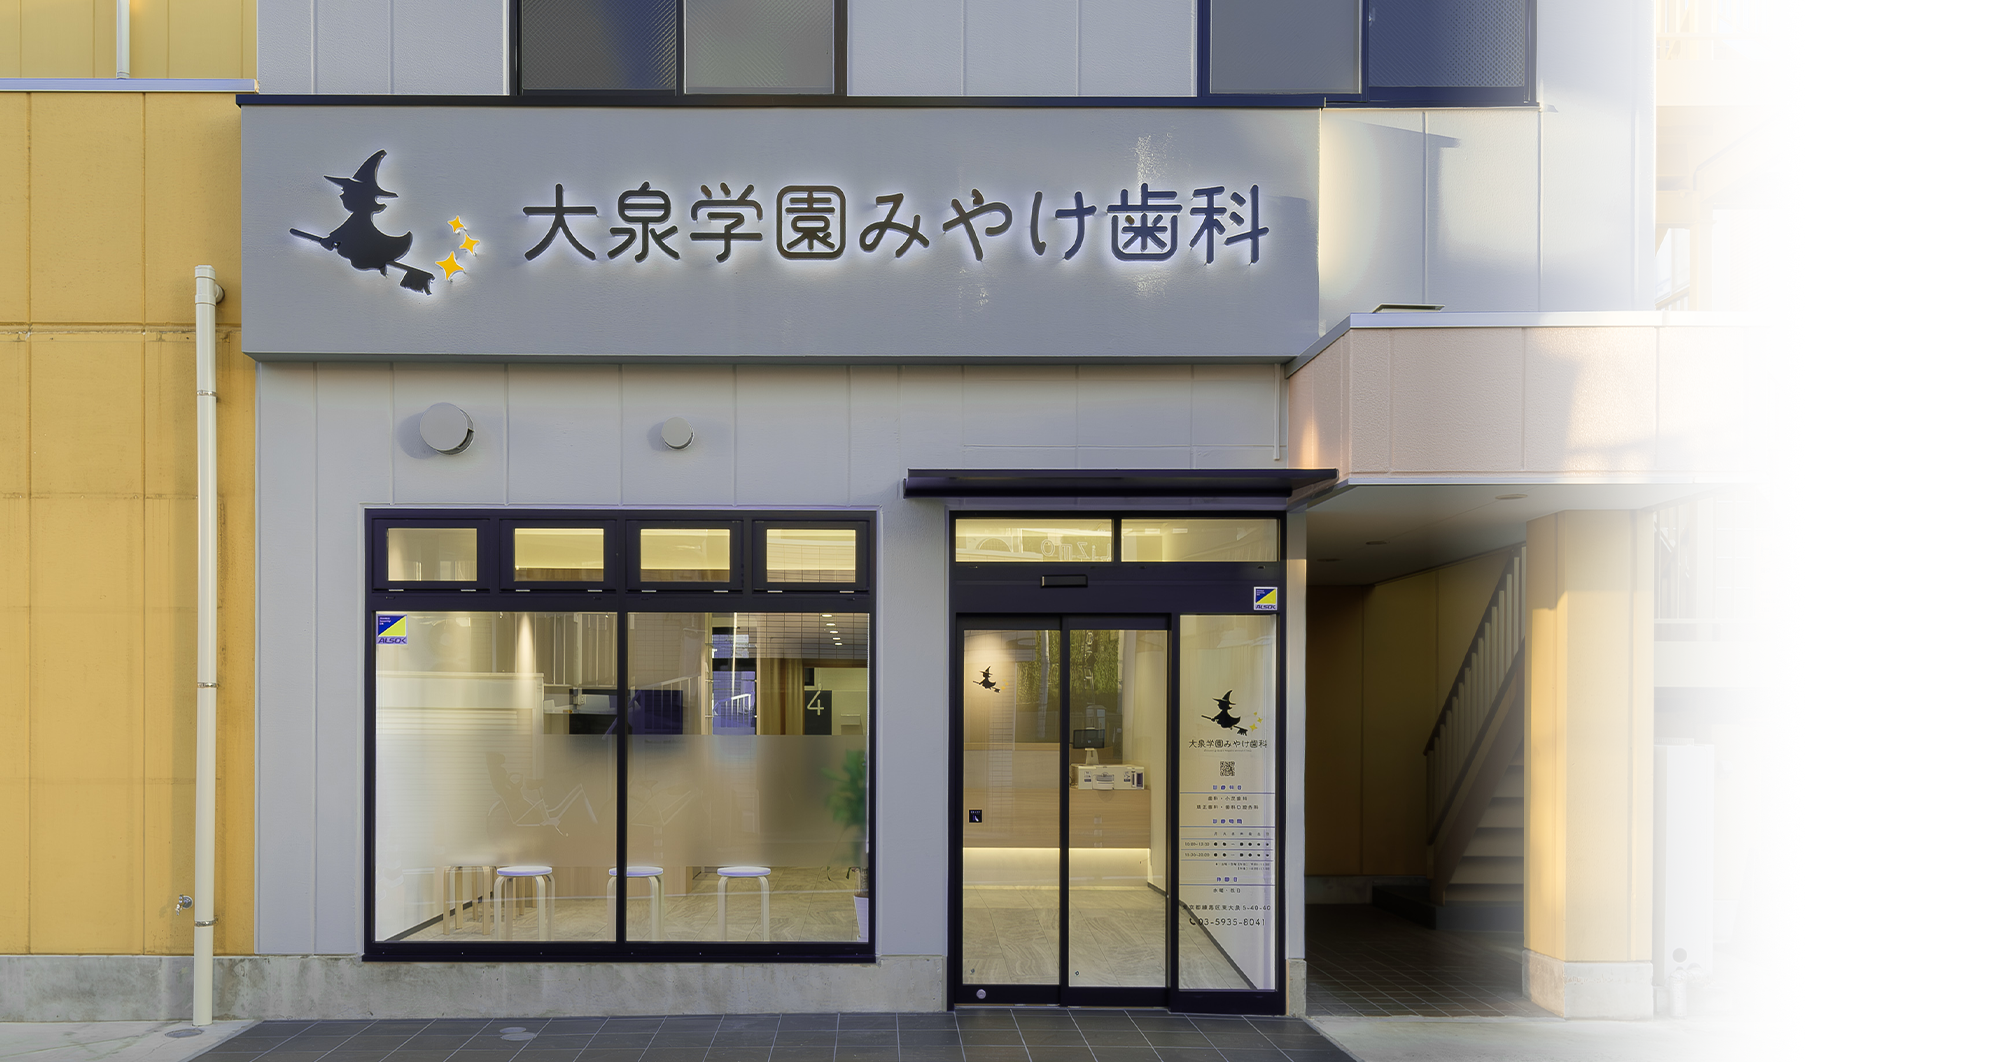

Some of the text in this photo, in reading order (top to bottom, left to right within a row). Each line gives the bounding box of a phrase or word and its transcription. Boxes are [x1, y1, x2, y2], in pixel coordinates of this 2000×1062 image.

[523, 181, 1269, 264] 大泉学園みやけ歯科
[1188, 739, 1268, 748] 大泉学園みやけ歯科
